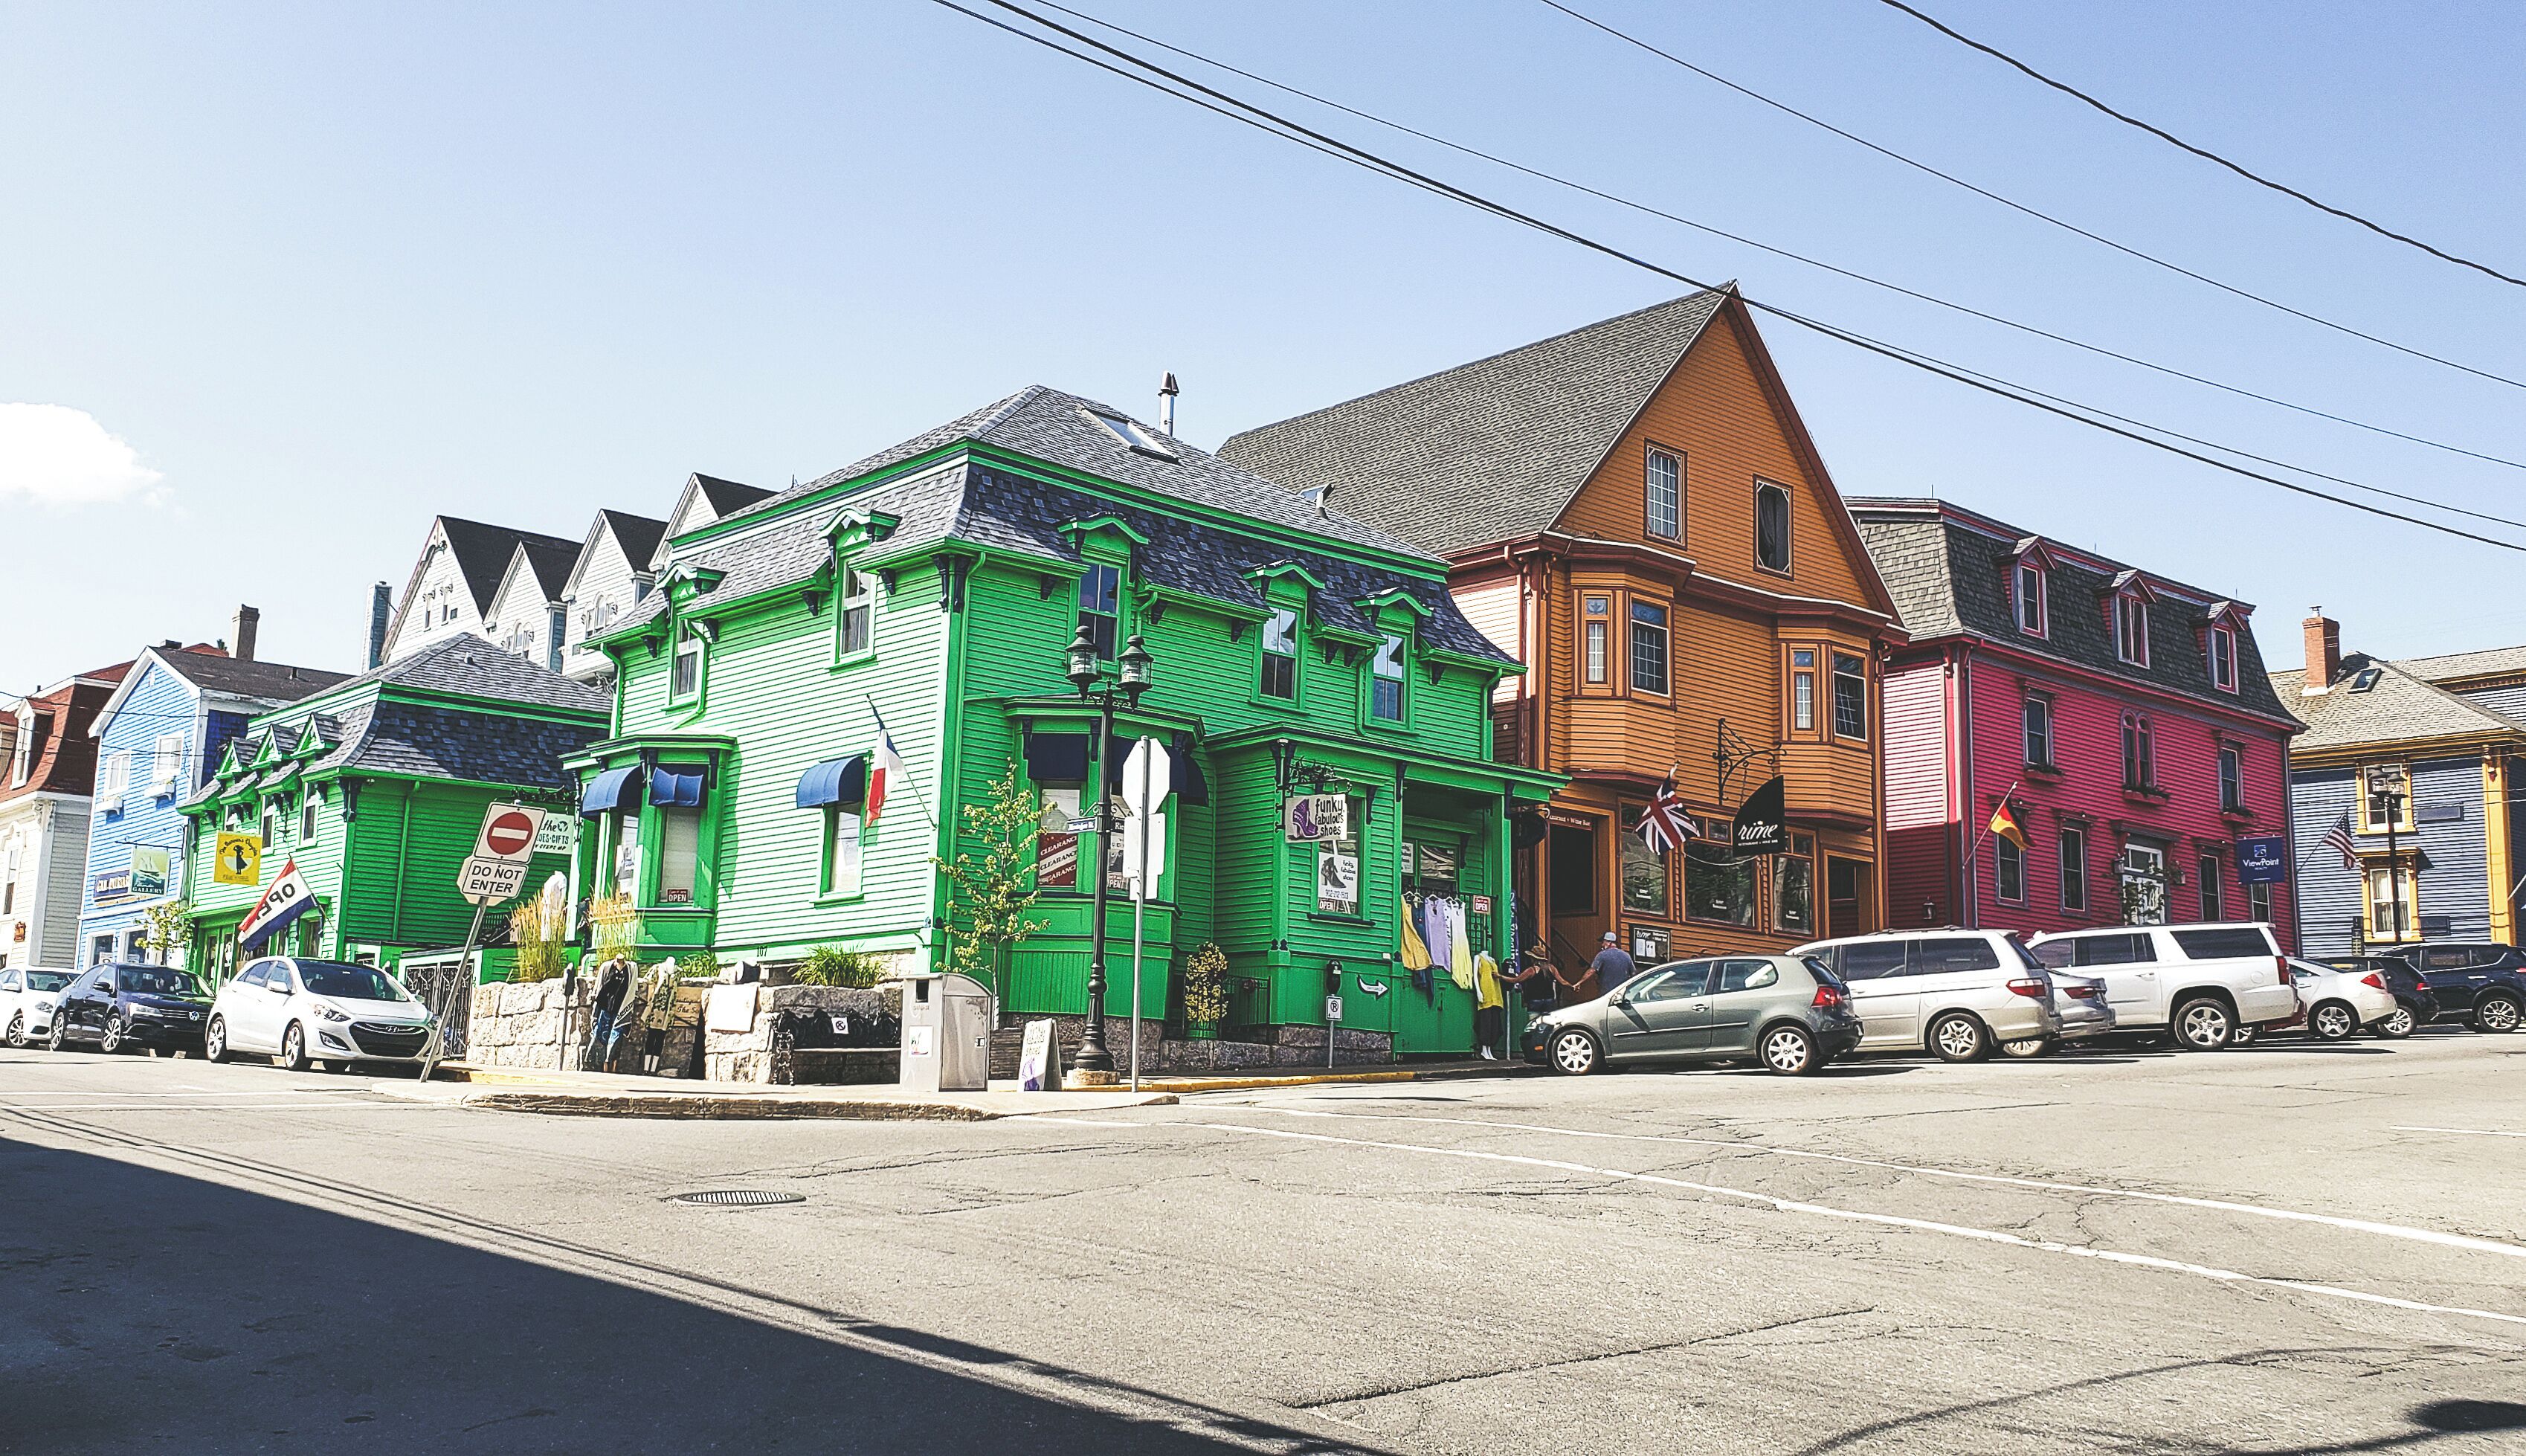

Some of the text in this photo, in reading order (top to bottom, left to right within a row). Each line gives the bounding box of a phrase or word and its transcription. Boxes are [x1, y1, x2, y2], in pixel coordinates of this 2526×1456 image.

[1315, 813, 1344, 825] fabulous
[1321, 825, 1341, 836] shoes
[1738, 822, 1778, 840] rime
[2242, 857, 2279, 867] ViewPoint
[471, 865, 522, 880] DO NOT
[132, 886, 164, 895] GALLERY
[470, 879, 514, 893] ENTER
[668, 894, 687, 902] OPEN
[1475, 902, 1488, 912] OPEN
[757, 945, 768, 957] 107
